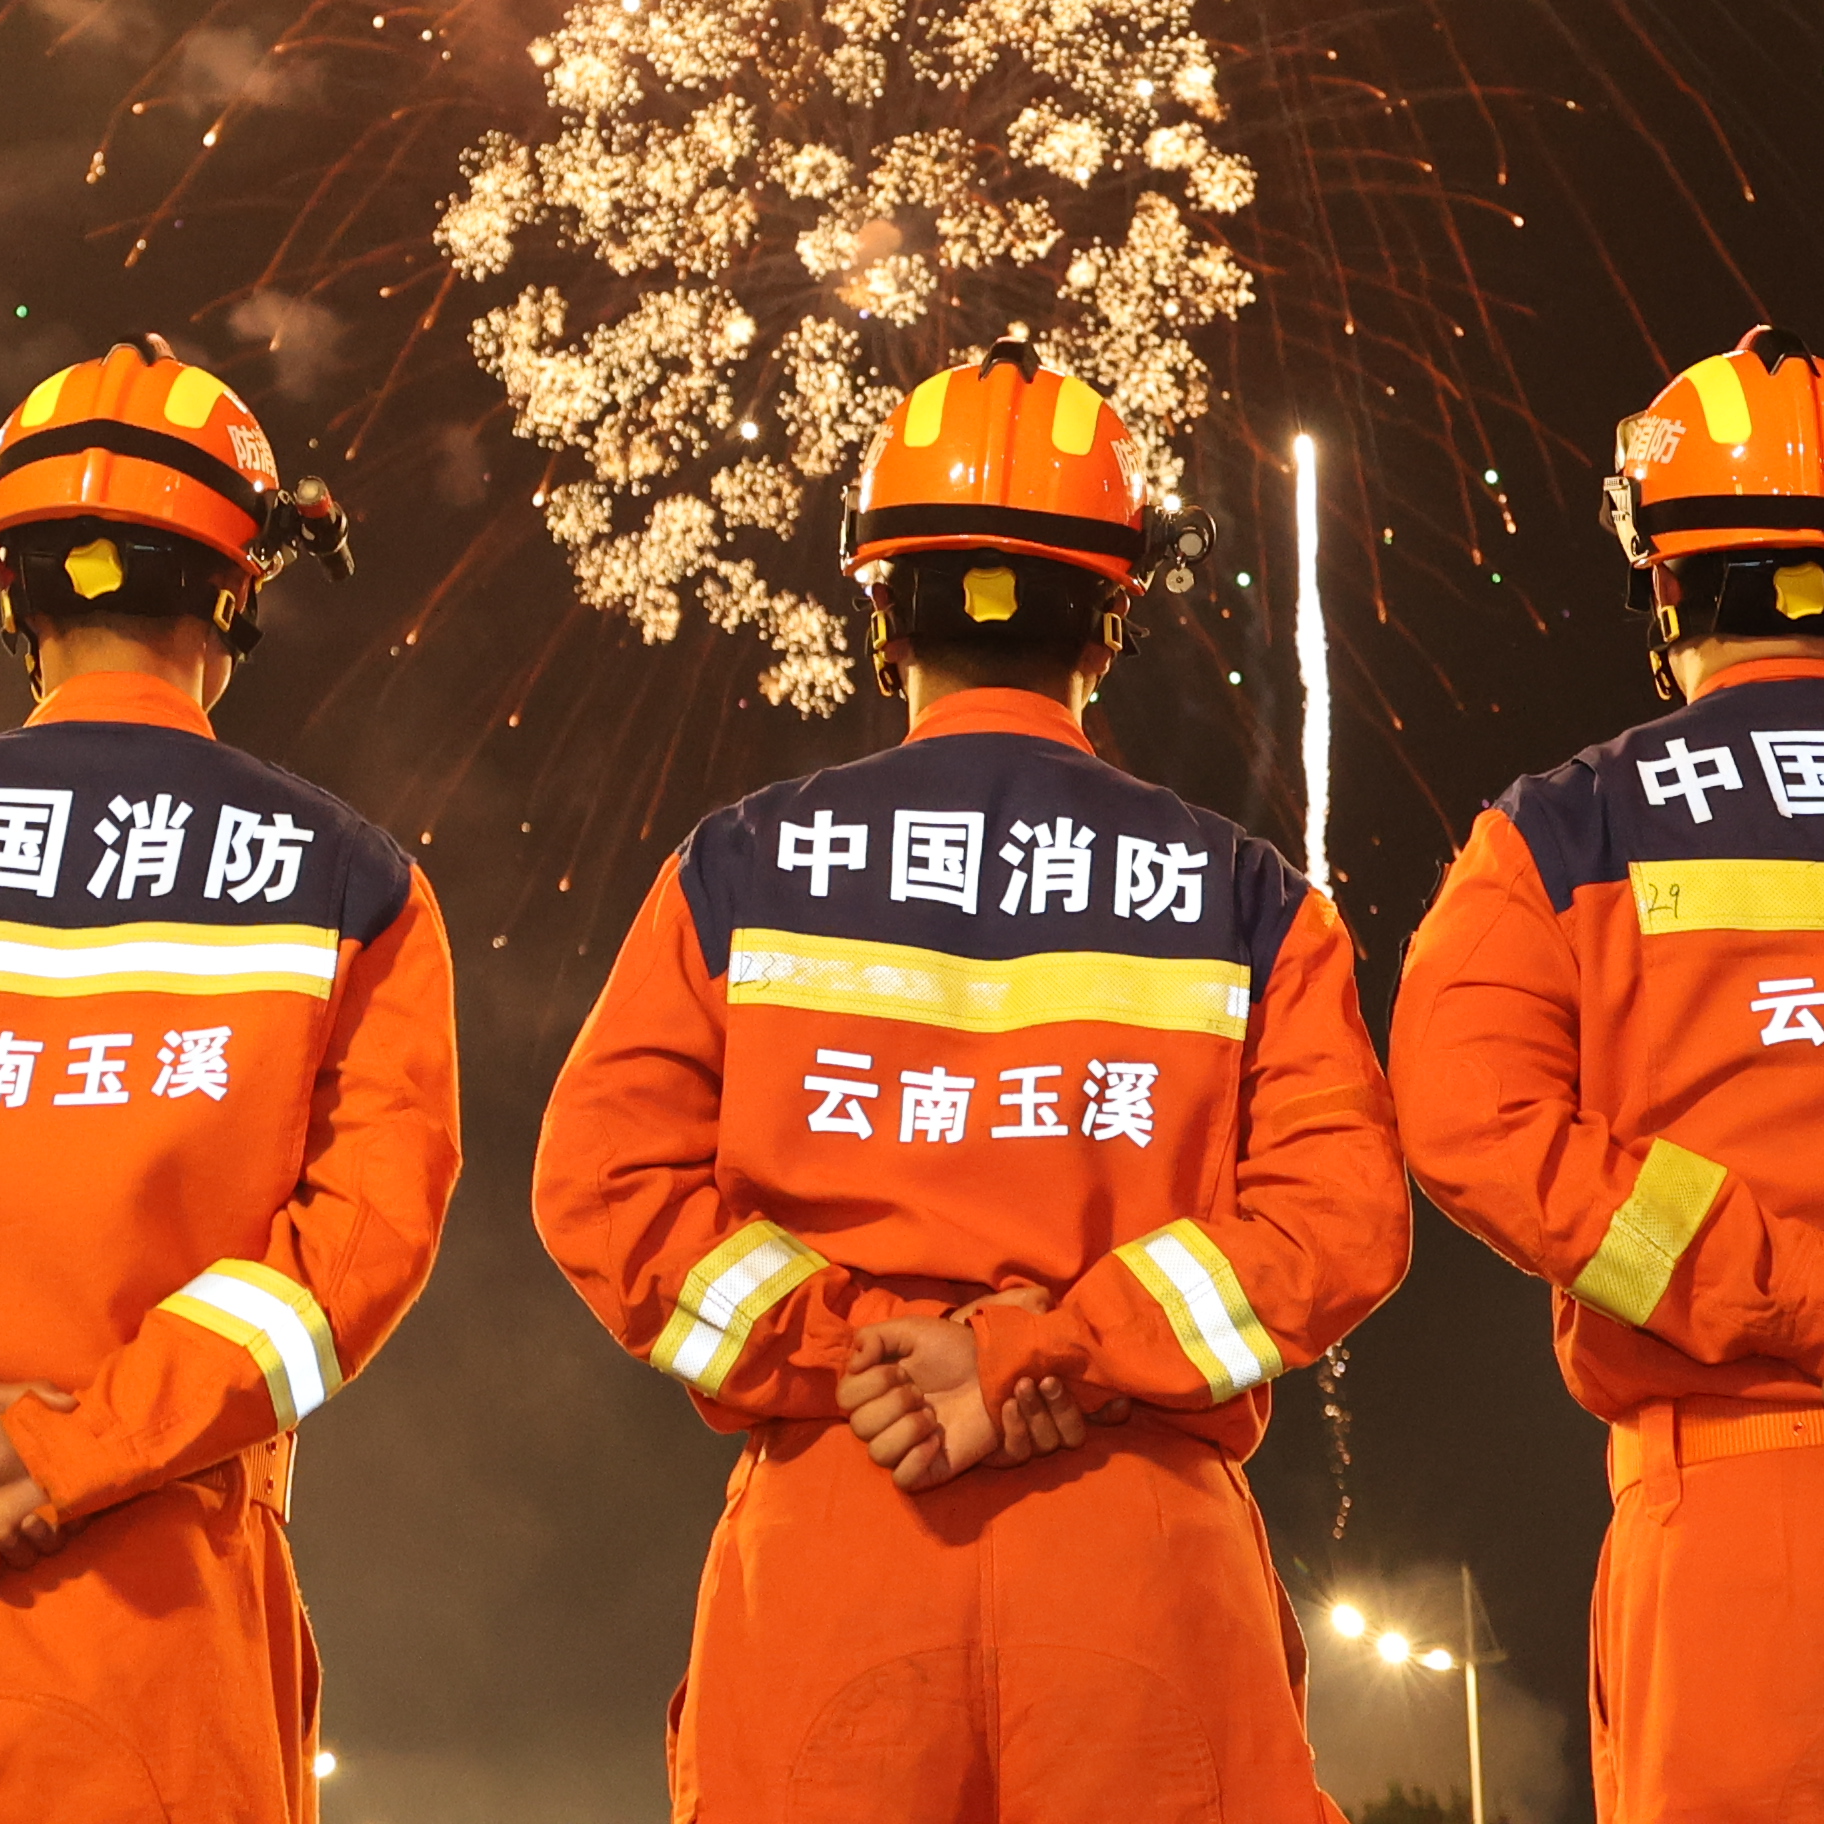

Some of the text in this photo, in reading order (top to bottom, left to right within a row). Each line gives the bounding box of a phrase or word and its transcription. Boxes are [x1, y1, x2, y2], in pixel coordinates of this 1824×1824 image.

[777, 809, 1209, 923] 中国消防
[1647, 882, 1680, 920] 29
[803, 1048, 1159, 1149] 云南玉溪
